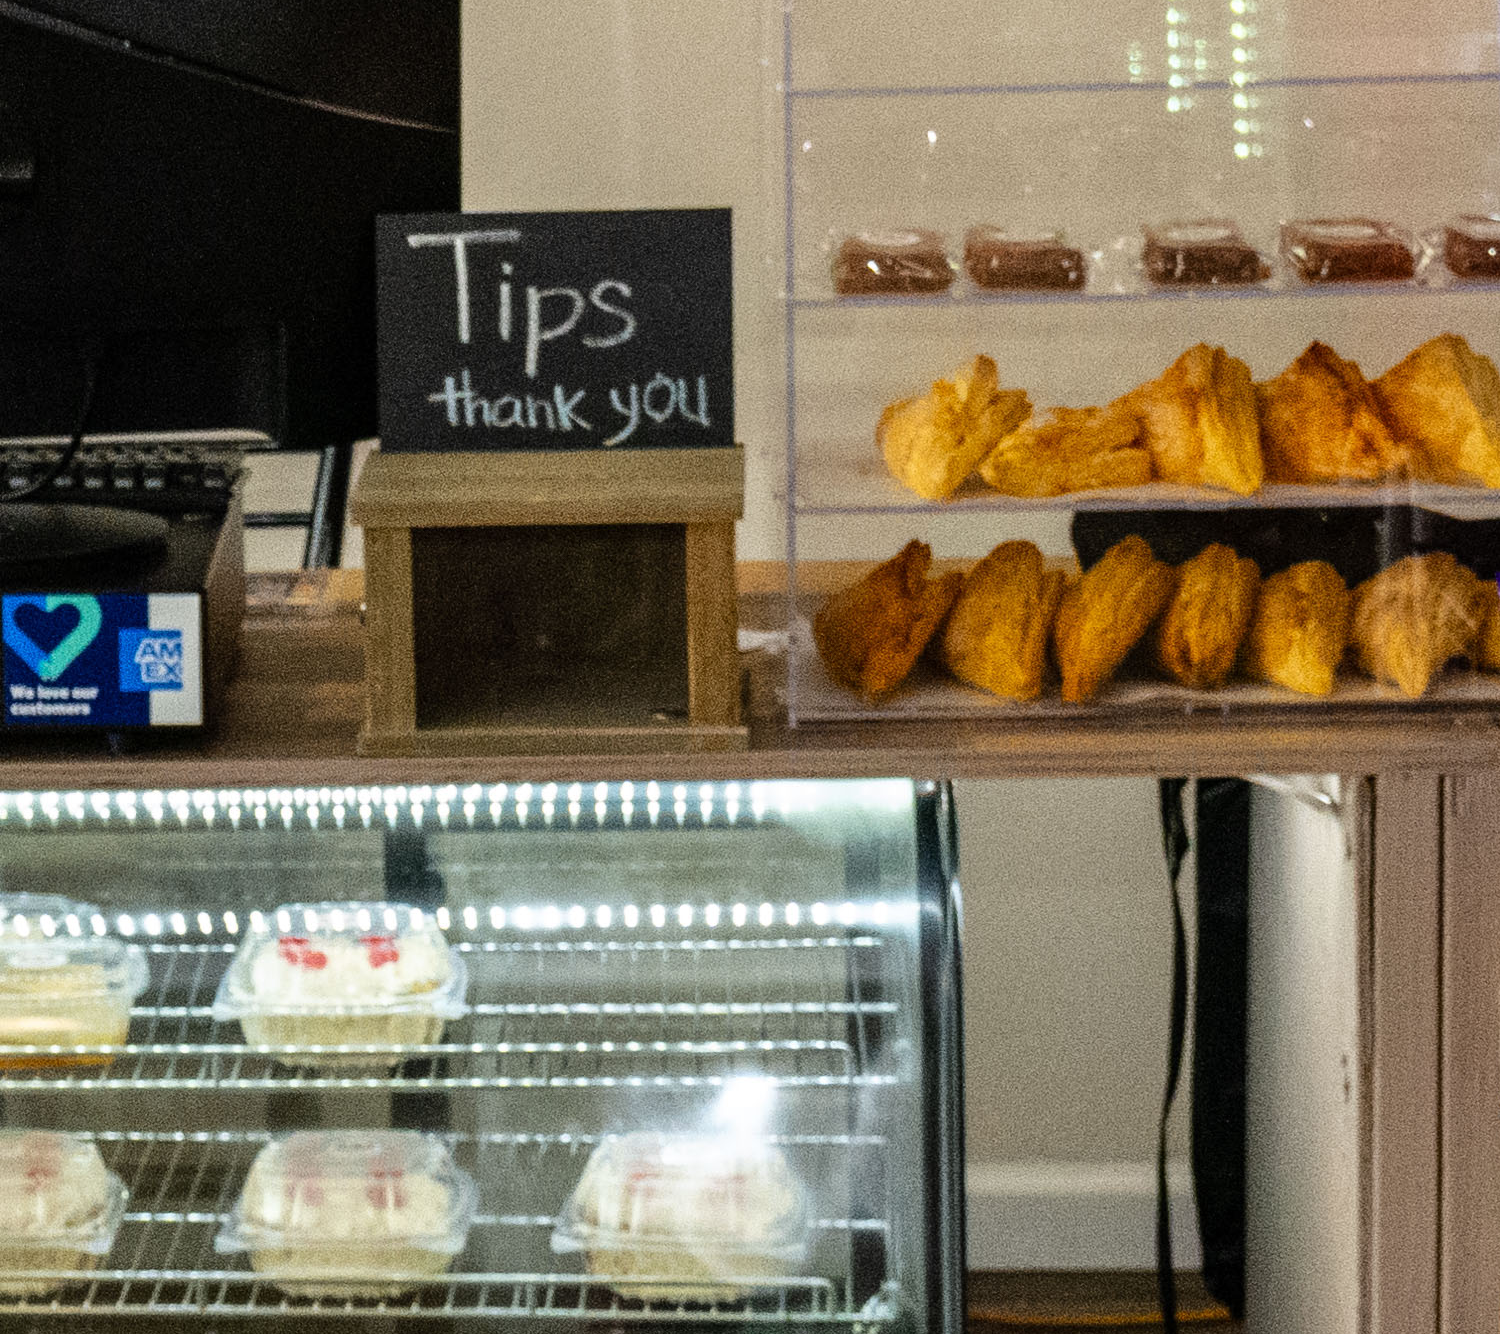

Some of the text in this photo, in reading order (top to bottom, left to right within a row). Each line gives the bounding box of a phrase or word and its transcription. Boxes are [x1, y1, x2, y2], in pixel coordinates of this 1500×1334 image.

[406, 229, 637, 379] Tips
[427, 367, 711, 447] thank you
[9, 684, 100, 700] We love our
[9, 701, 92, 717] customers
